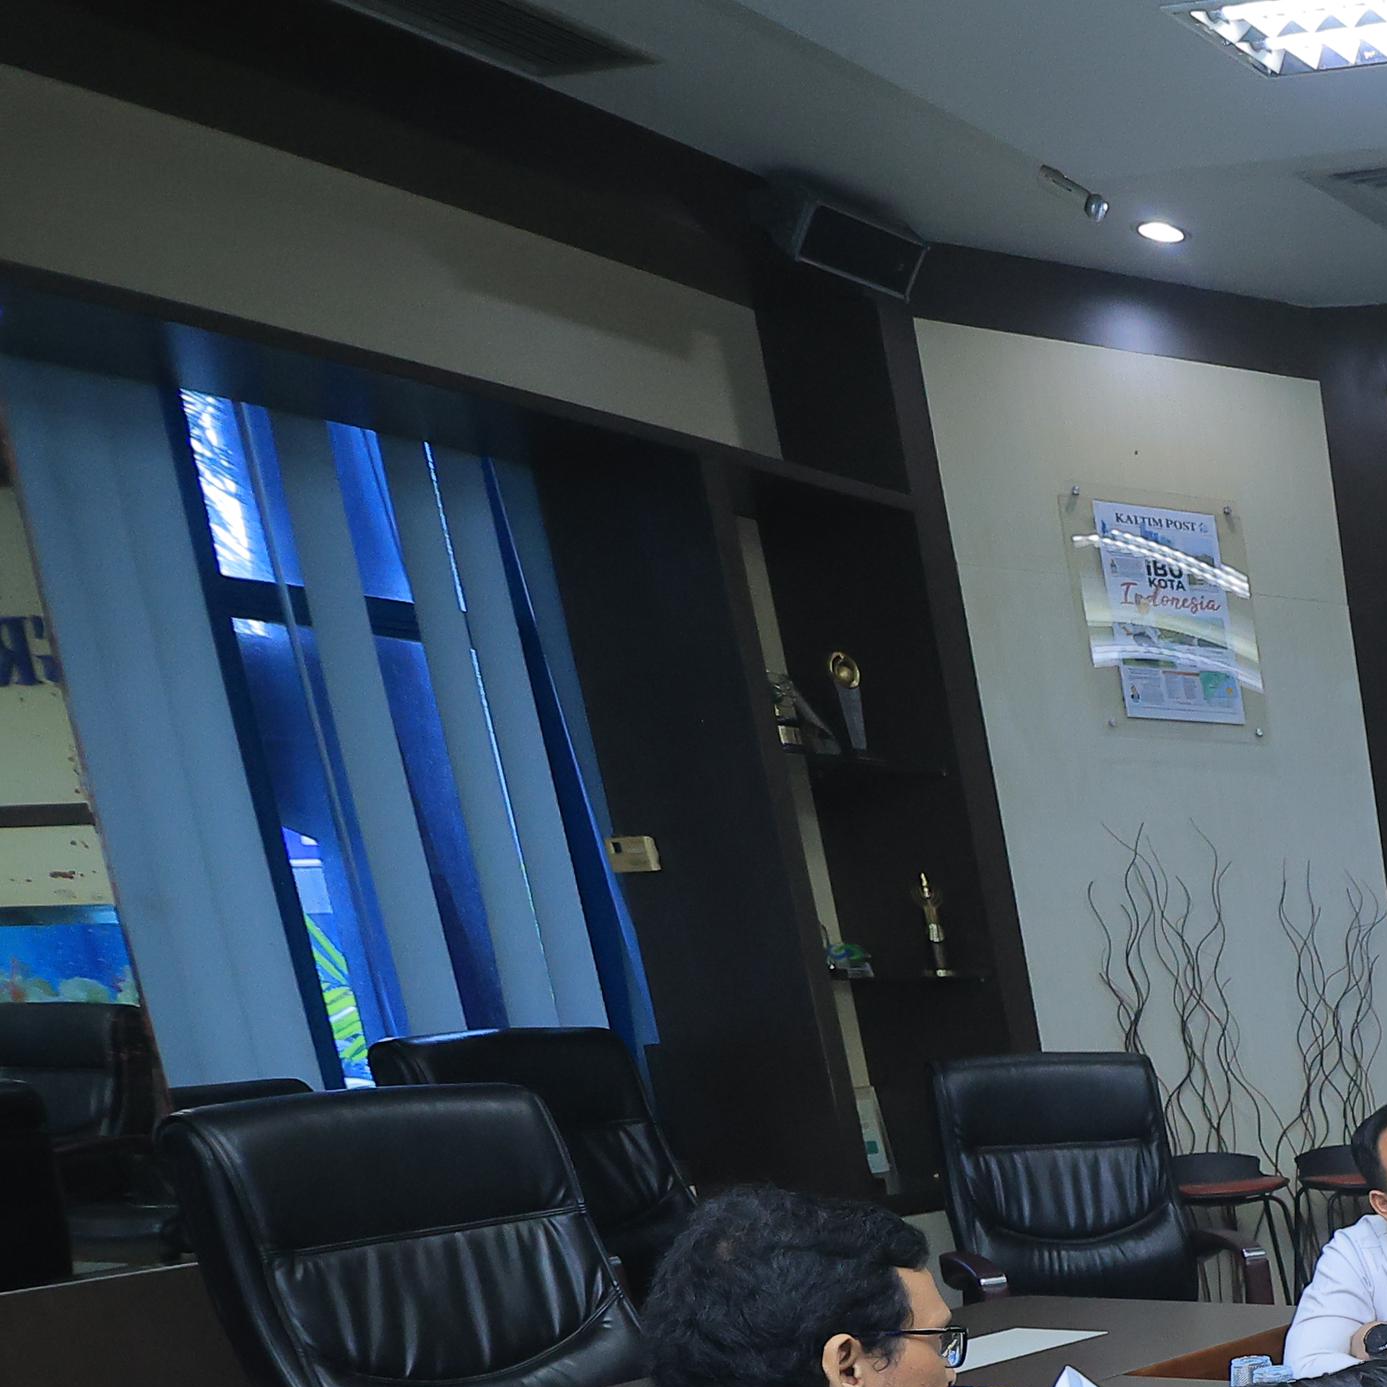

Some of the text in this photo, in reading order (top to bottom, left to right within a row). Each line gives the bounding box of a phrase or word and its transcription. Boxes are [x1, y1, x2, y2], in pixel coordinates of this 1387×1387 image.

[1115, 512, 1197, 532] KALTIM POST
[1148, 577, 1187, 592] KOTA
[1120, 581, 1221, 615] Indonesia
